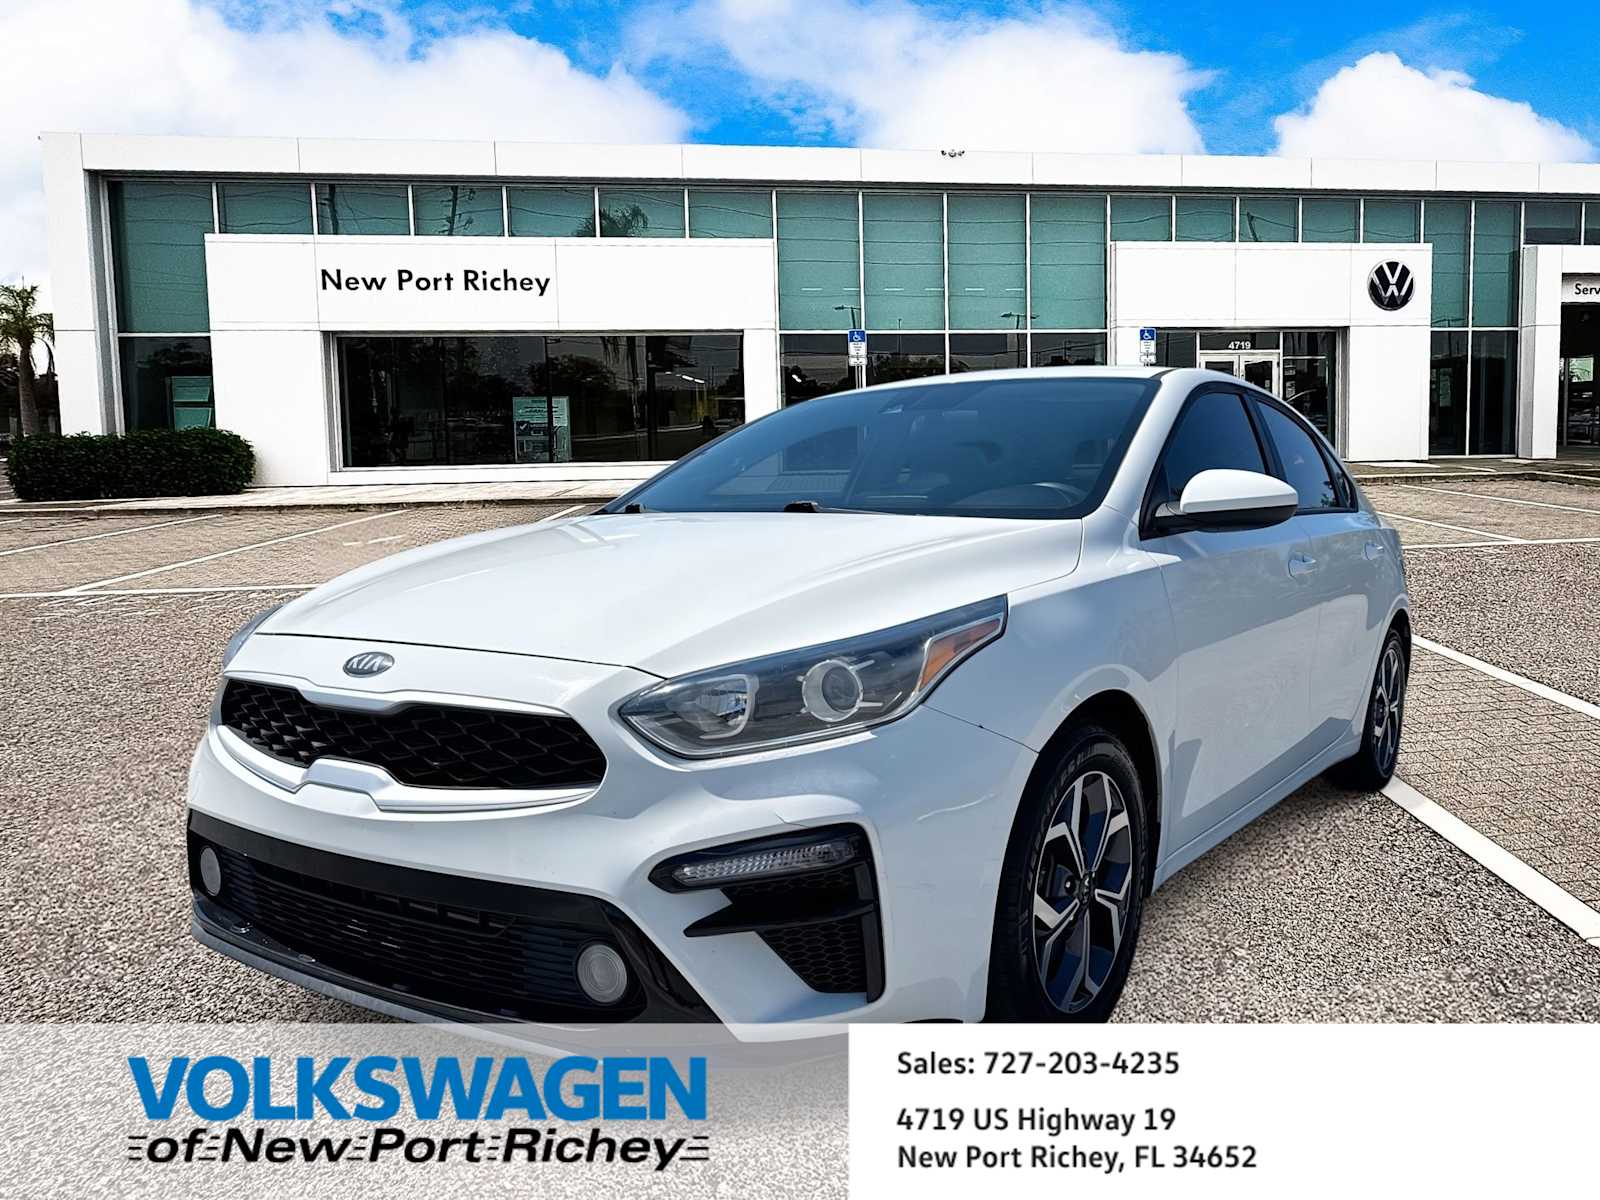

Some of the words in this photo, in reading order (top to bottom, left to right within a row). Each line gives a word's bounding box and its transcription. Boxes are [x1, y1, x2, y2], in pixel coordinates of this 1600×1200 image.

[321, 269, 387, 290] New
[398, 269, 454, 290] Port
[463, 269, 551, 296] Richey
[1228, 341, 1251, 350] 4719
[346, 653, 386, 672] KIA
